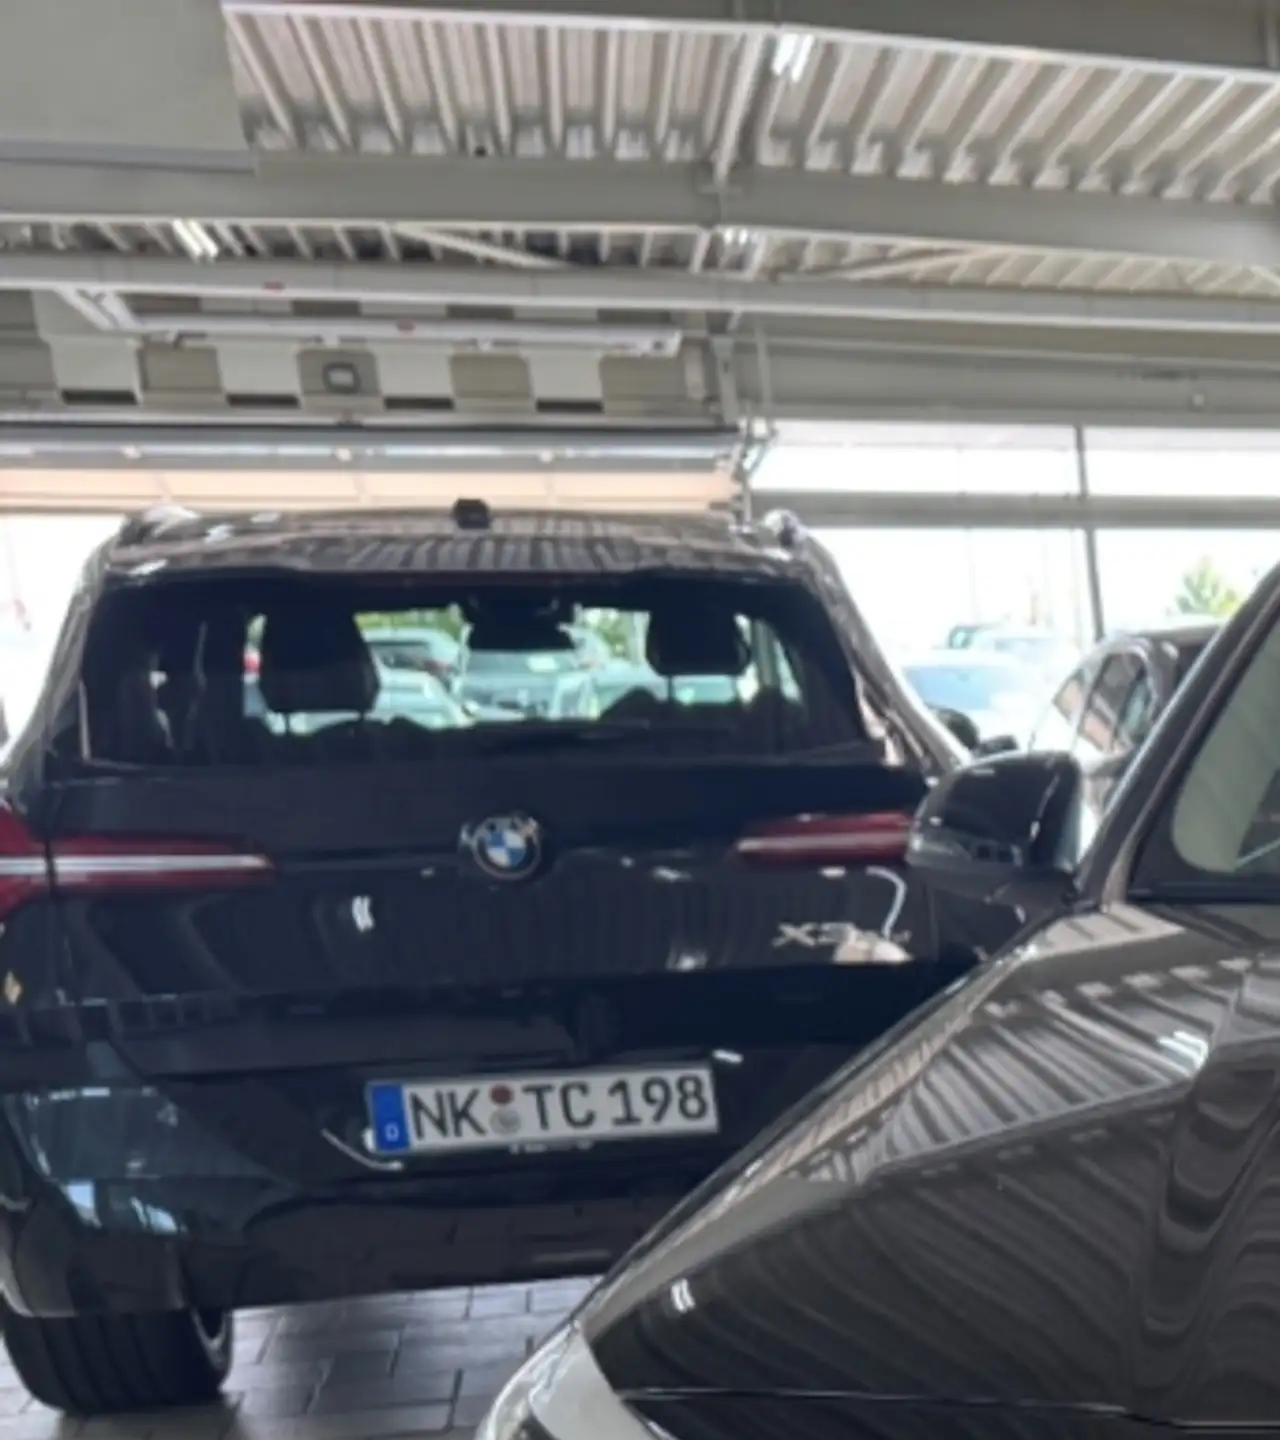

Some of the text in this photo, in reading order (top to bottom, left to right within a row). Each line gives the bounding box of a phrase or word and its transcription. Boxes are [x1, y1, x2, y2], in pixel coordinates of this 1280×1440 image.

[409, 1074, 708, 1140] NK TC 198
